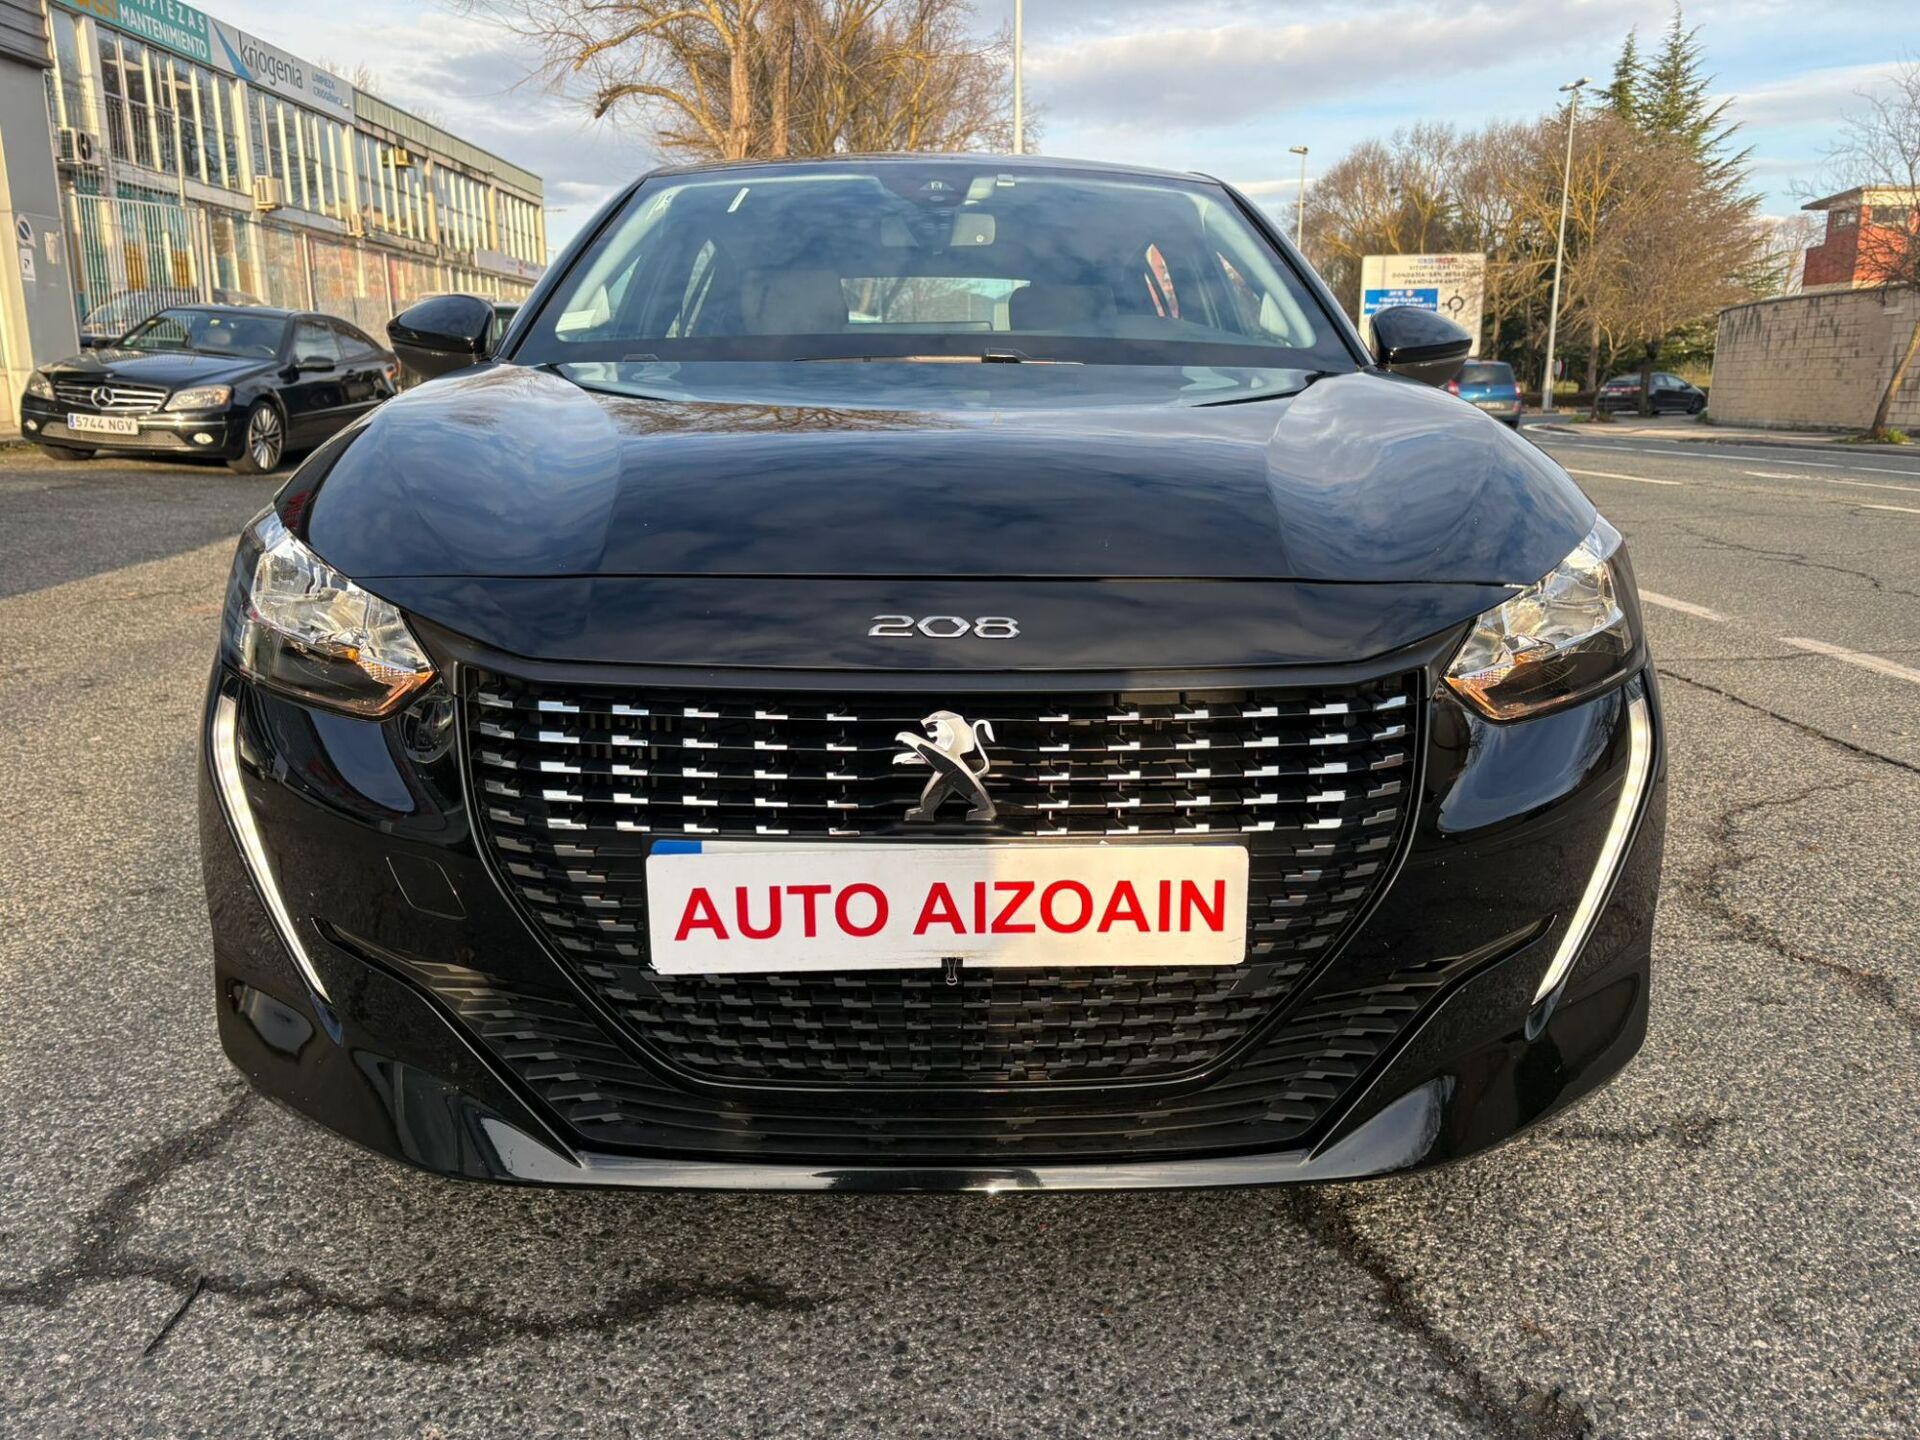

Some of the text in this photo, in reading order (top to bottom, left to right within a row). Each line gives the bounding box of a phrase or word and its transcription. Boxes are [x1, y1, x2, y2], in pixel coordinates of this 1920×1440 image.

[119, 4, 208, 58] MANTENIMIENTO
[238, 30, 303, 89] kriogenia
[76, 416, 132, 431] 5744 NGV
[868, 614, 1021, 639] 208
[674, 879, 1227, 942] AUTO AIZOAIN
